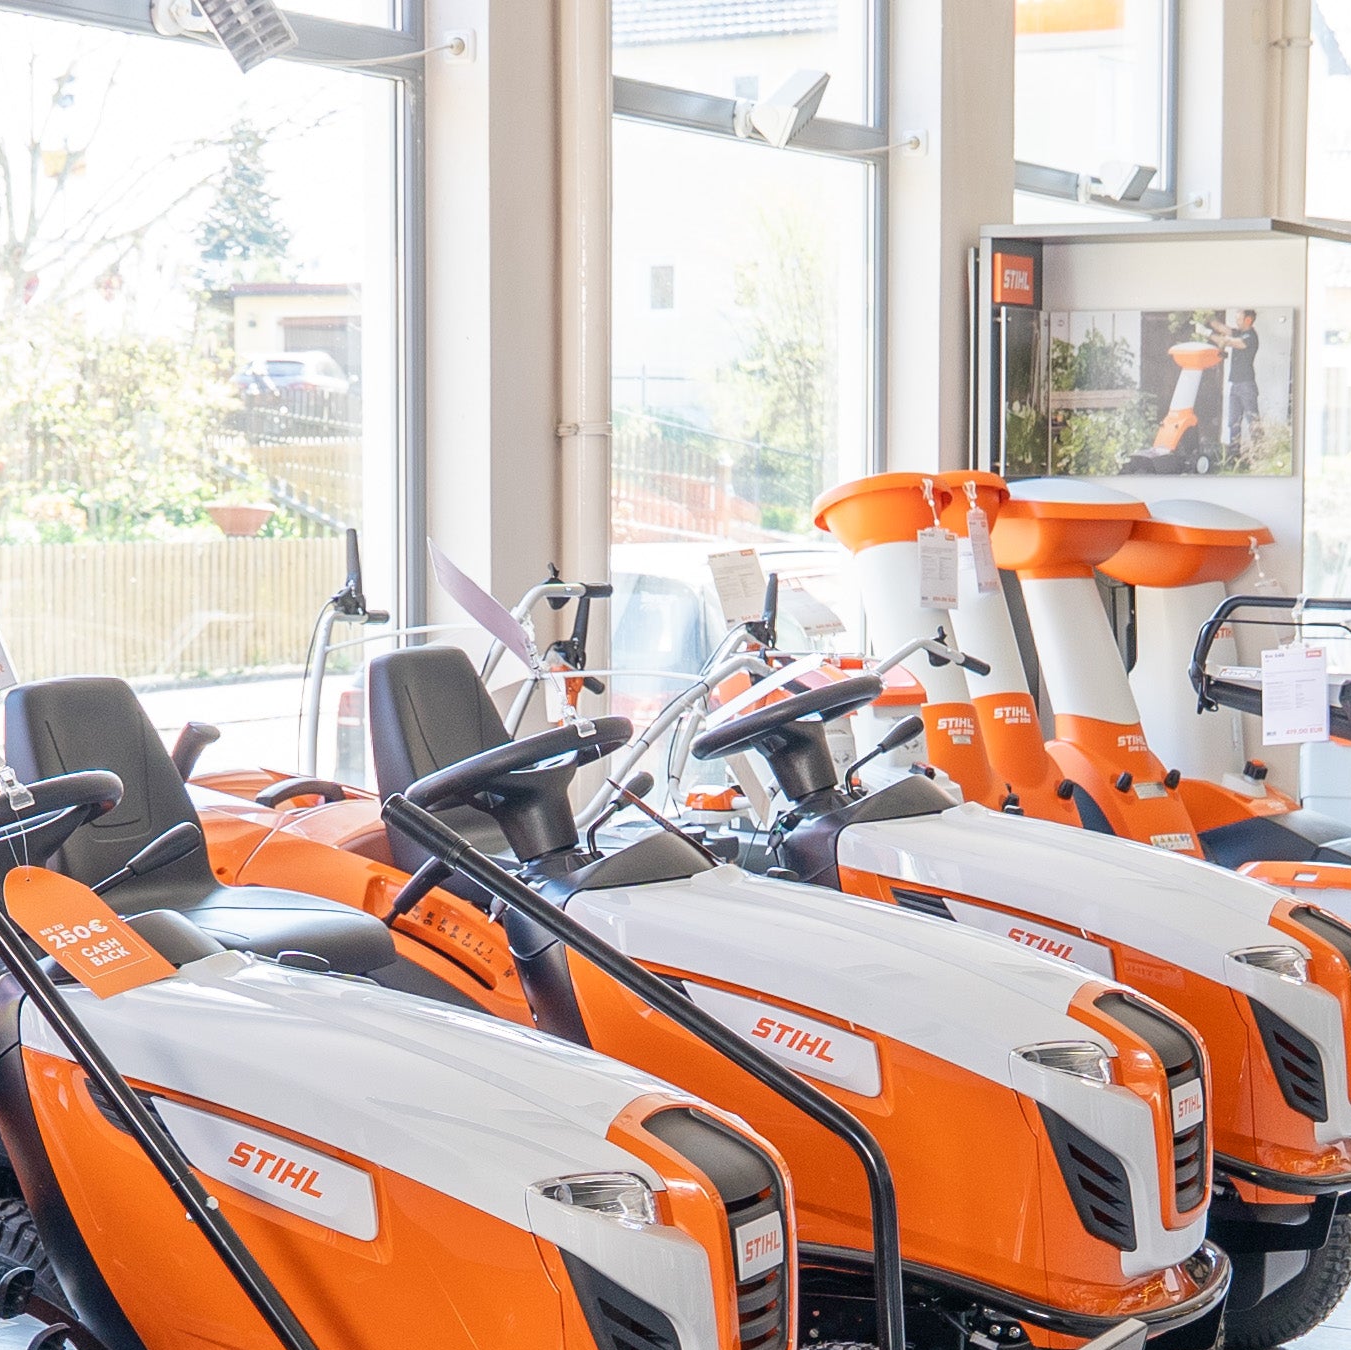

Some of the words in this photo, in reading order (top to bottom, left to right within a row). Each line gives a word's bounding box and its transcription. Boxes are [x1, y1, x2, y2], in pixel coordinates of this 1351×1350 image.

[1004, 269, 1030, 291] STIHL
[993, 706, 1031, 719] STIHL
[937, 717, 975, 731] STIHL
[48, 918, 109, 950] 250€
[81, 937, 122, 958] CASH
[90, 946, 131, 967] BACK
[1008, 928, 1076, 963] STIHL
[751, 1016, 835, 1063] STIHL
[1178, 1097, 1202, 1118] STIHL
[228, 1141, 323, 1199] STIHL
[744, 1230, 781, 1263] STIHL
